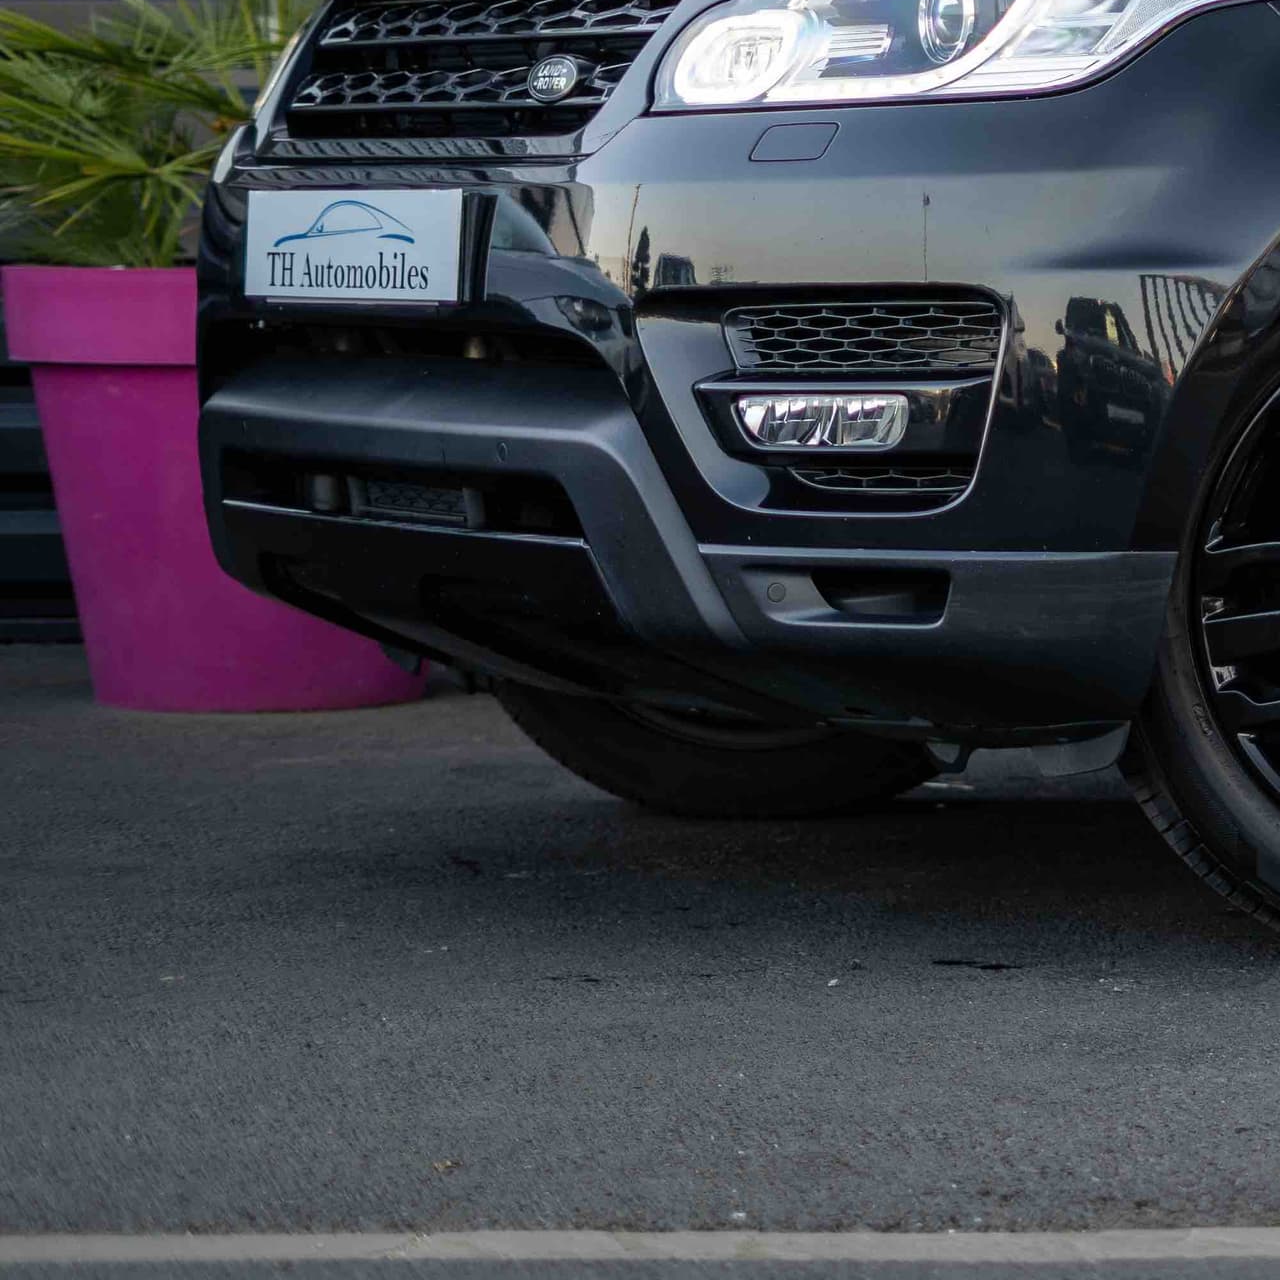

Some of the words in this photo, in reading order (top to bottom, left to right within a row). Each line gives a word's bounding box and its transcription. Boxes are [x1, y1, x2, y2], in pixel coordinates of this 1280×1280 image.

[537, 65, 562, 77] LAND
[536, 77, 567, 90] ROVER
[267, 252, 296, 287] TH
[300, 252, 429, 290] Automobiles
